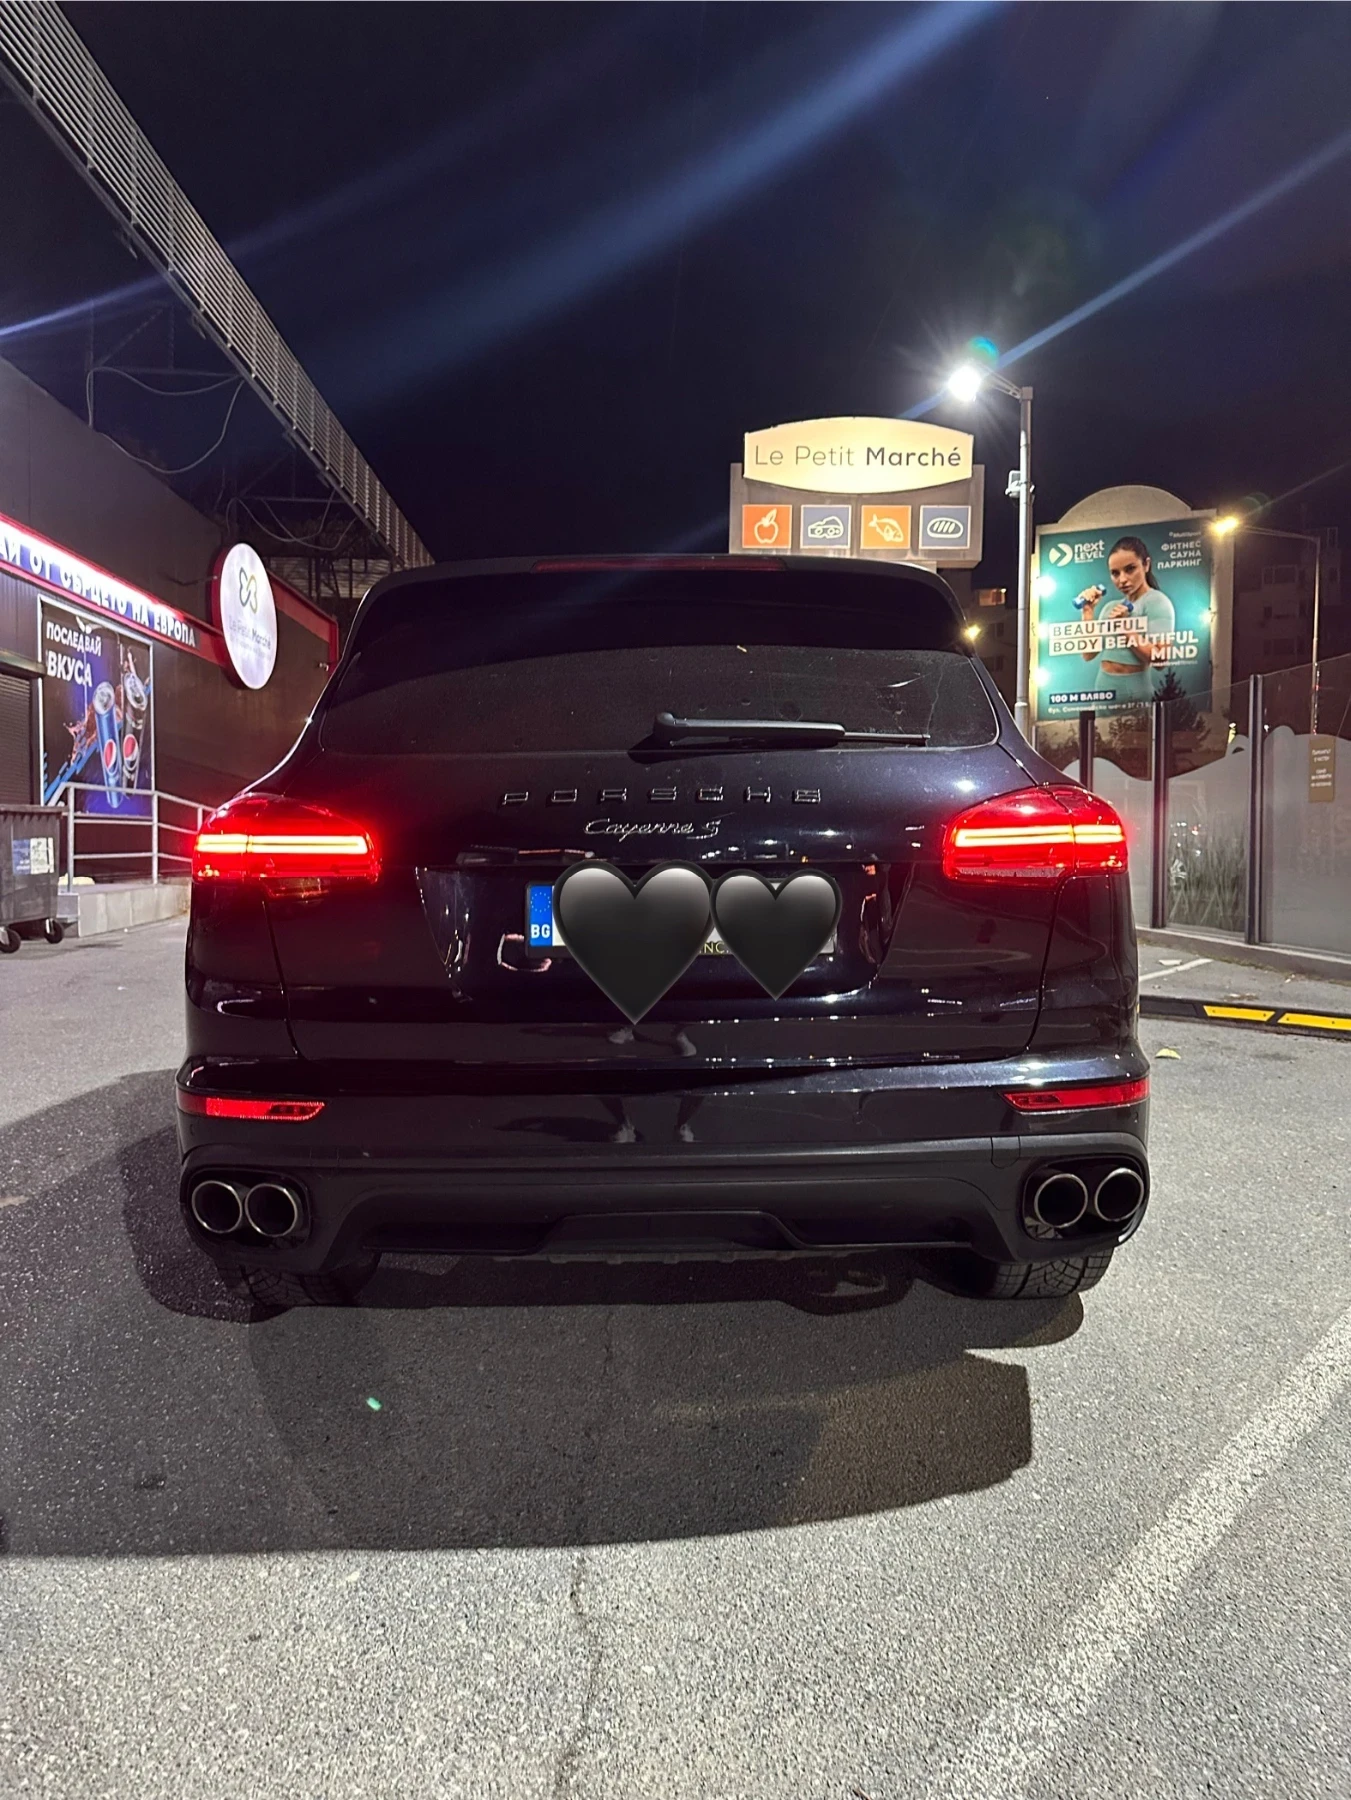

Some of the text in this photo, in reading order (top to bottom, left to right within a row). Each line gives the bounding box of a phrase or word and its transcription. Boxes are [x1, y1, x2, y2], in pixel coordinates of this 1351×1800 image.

[755, 445, 961, 467] Le Petit Marché
[1074, 539, 1105, 552] next
[1161, 540, 1201, 551] ФИТНЕС
[1074, 550, 1105, 560] LEVEL
[1169, 550, 1201, 559] САУНА
[1157, 558, 1202, 570] ПАРКИНГ
[30, 547, 50, 580] ОТ
[60, 563, 127, 616] СЪРЦЕТО
[132, 600, 149, 628] НА
[155, 609, 195, 647] ЕВРОПА
[1053, 619, 1145, 637] BEAUTIFUL
[46, 621, 102, 657] ПОСЛЕДВАЙ
[1053, 630, 1199, 652] BODY BEAUTIFUL
[1151, 645, 1198, 661] MIND
[47, 650, 93, 688] ВКУСА
[1050, 694, 1068, 703] 100
[1080, 691, 1113, 702] ВЛЯВО
[501, 786, 821, 805] PORSCHE
[584, 817, 694, 842] Cayenne
[530, 923, 550, 939] BG
